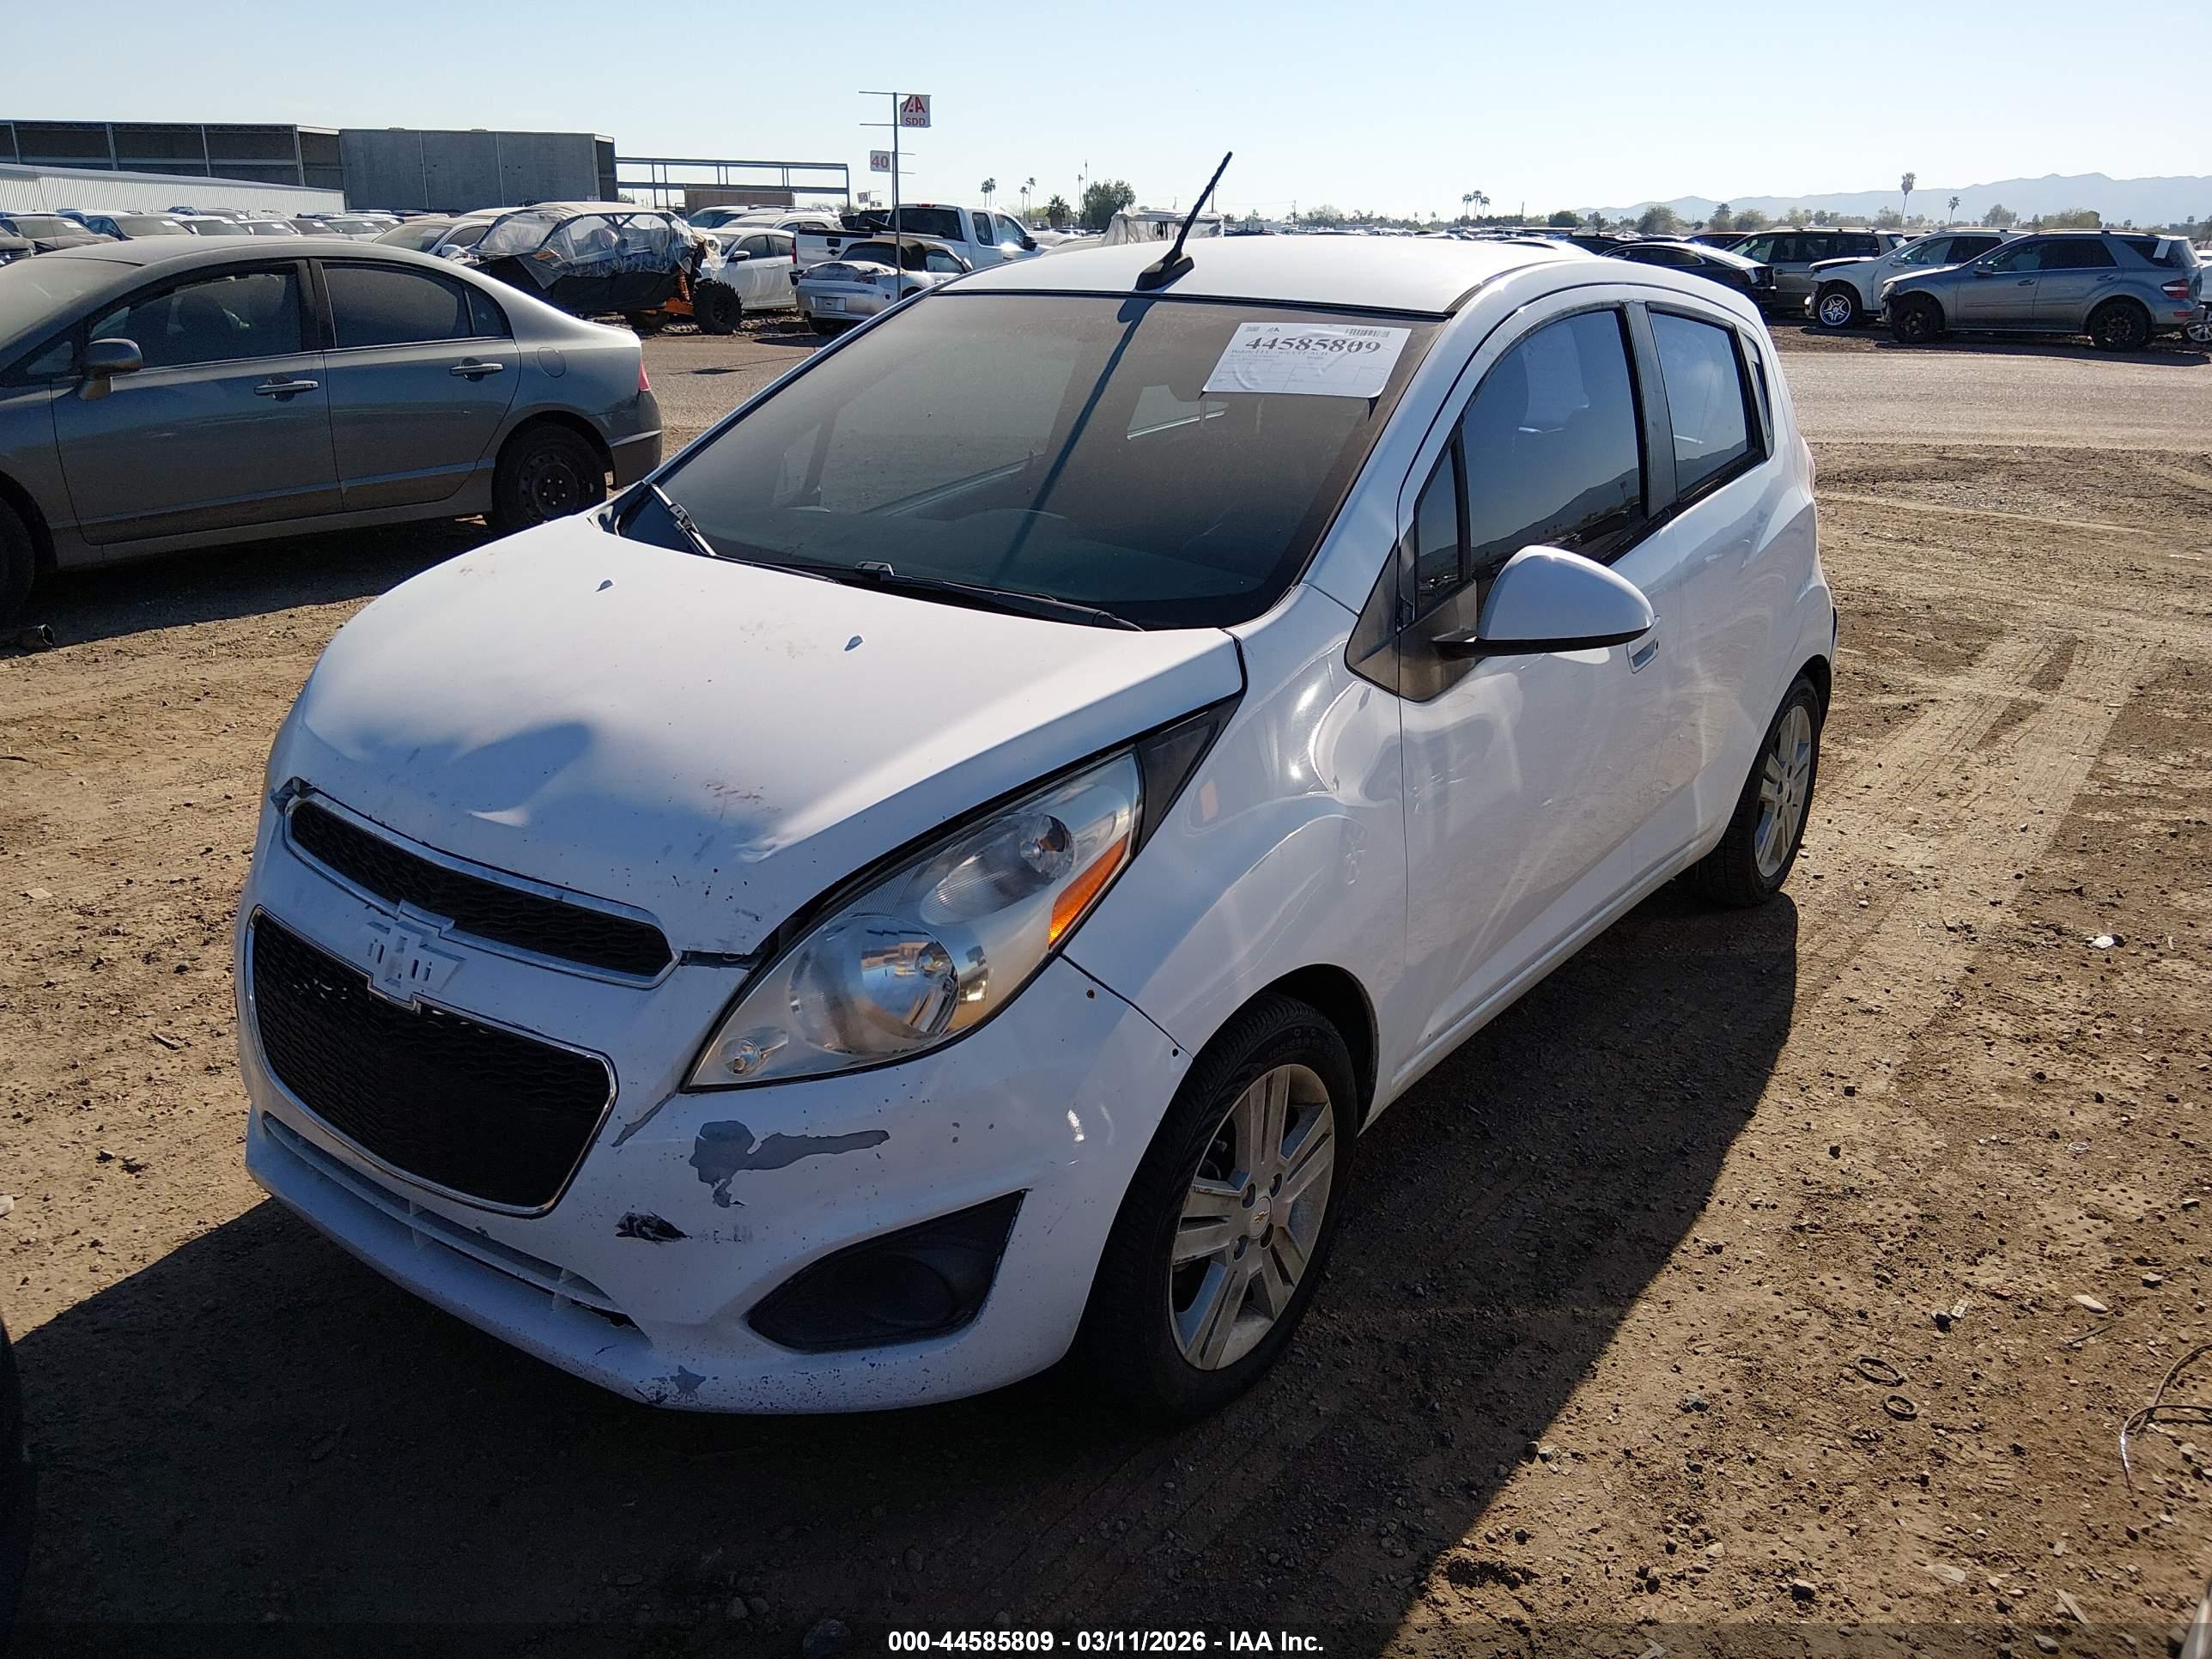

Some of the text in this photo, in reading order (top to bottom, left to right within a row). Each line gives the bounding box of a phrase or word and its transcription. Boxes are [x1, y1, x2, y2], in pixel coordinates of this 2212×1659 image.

[905, 117, 926, 126] SDD
[871, 155, 889, 168] 40
[1245, 337, 1382, 355] 44585809
